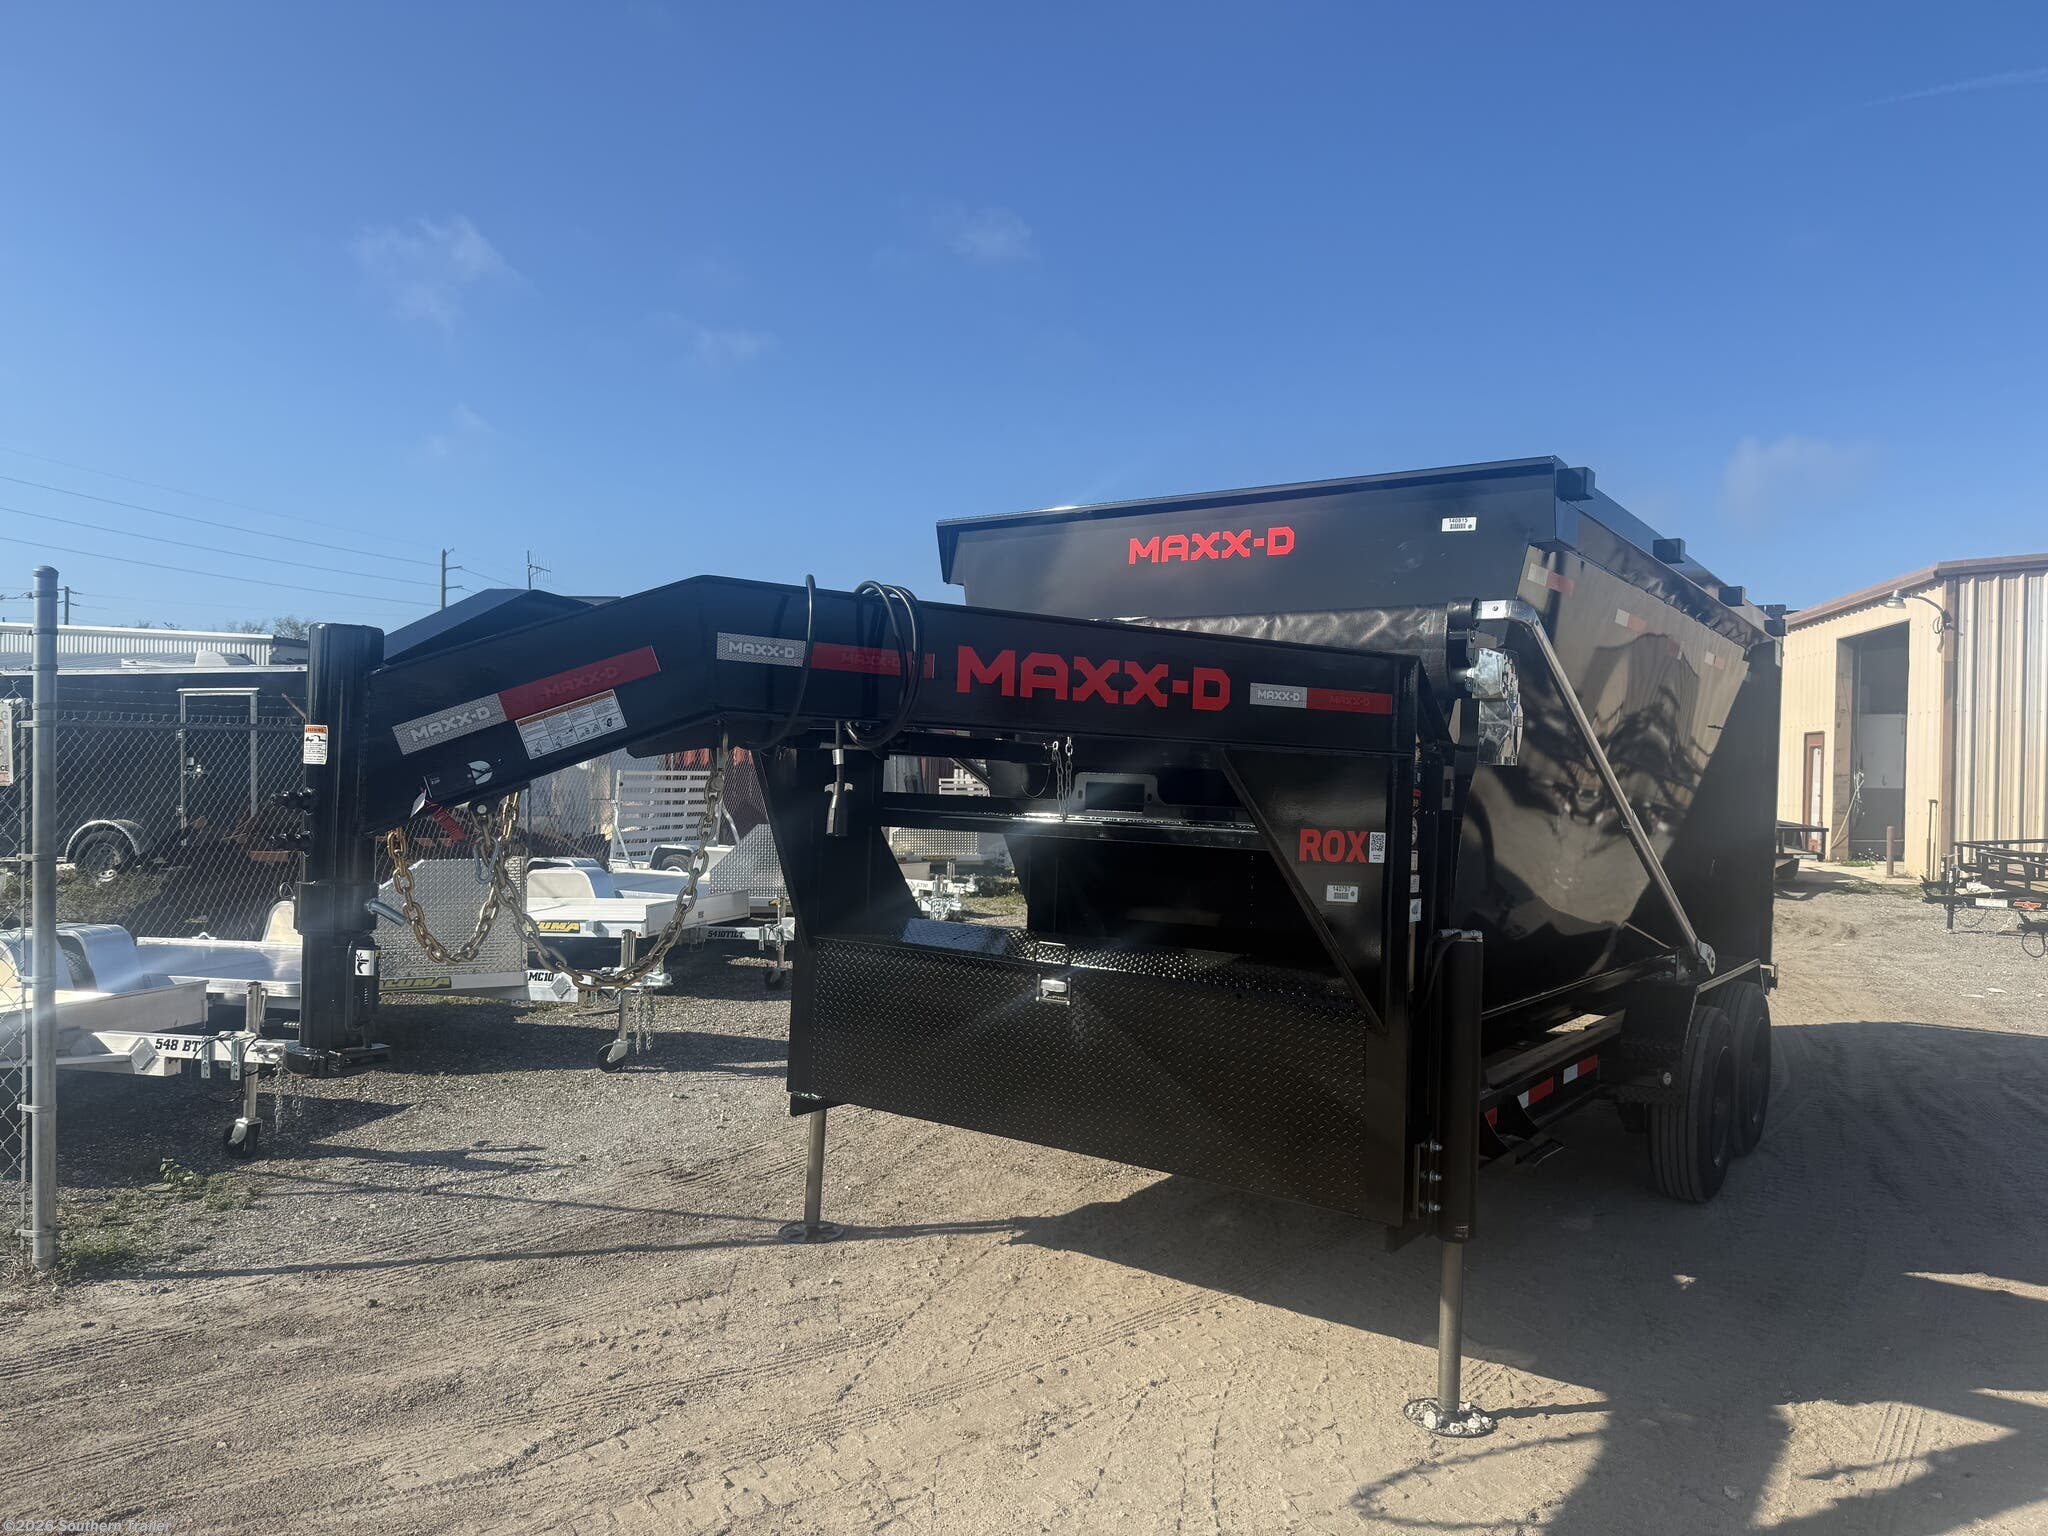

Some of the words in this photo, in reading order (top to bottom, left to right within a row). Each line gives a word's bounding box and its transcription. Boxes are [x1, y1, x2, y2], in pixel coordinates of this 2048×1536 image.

[1128, 526, 1295, 565] MAXX-D
[728, 640, 795, 659] MAXX-D
[544, 667, 618, 696] MAXX-D
[956, 645, 1231, 712] MAXX-D
[1257, 689, 1300, 702] MAXX-D
[410, 706, 491, 742] MAXX-D
[1299, 829, 1369, 864] ROX
[528, 972, 554, 982] MC10
[155, 1038, 179, 1051] 548
[182, 1040, 203, 1052] BT
